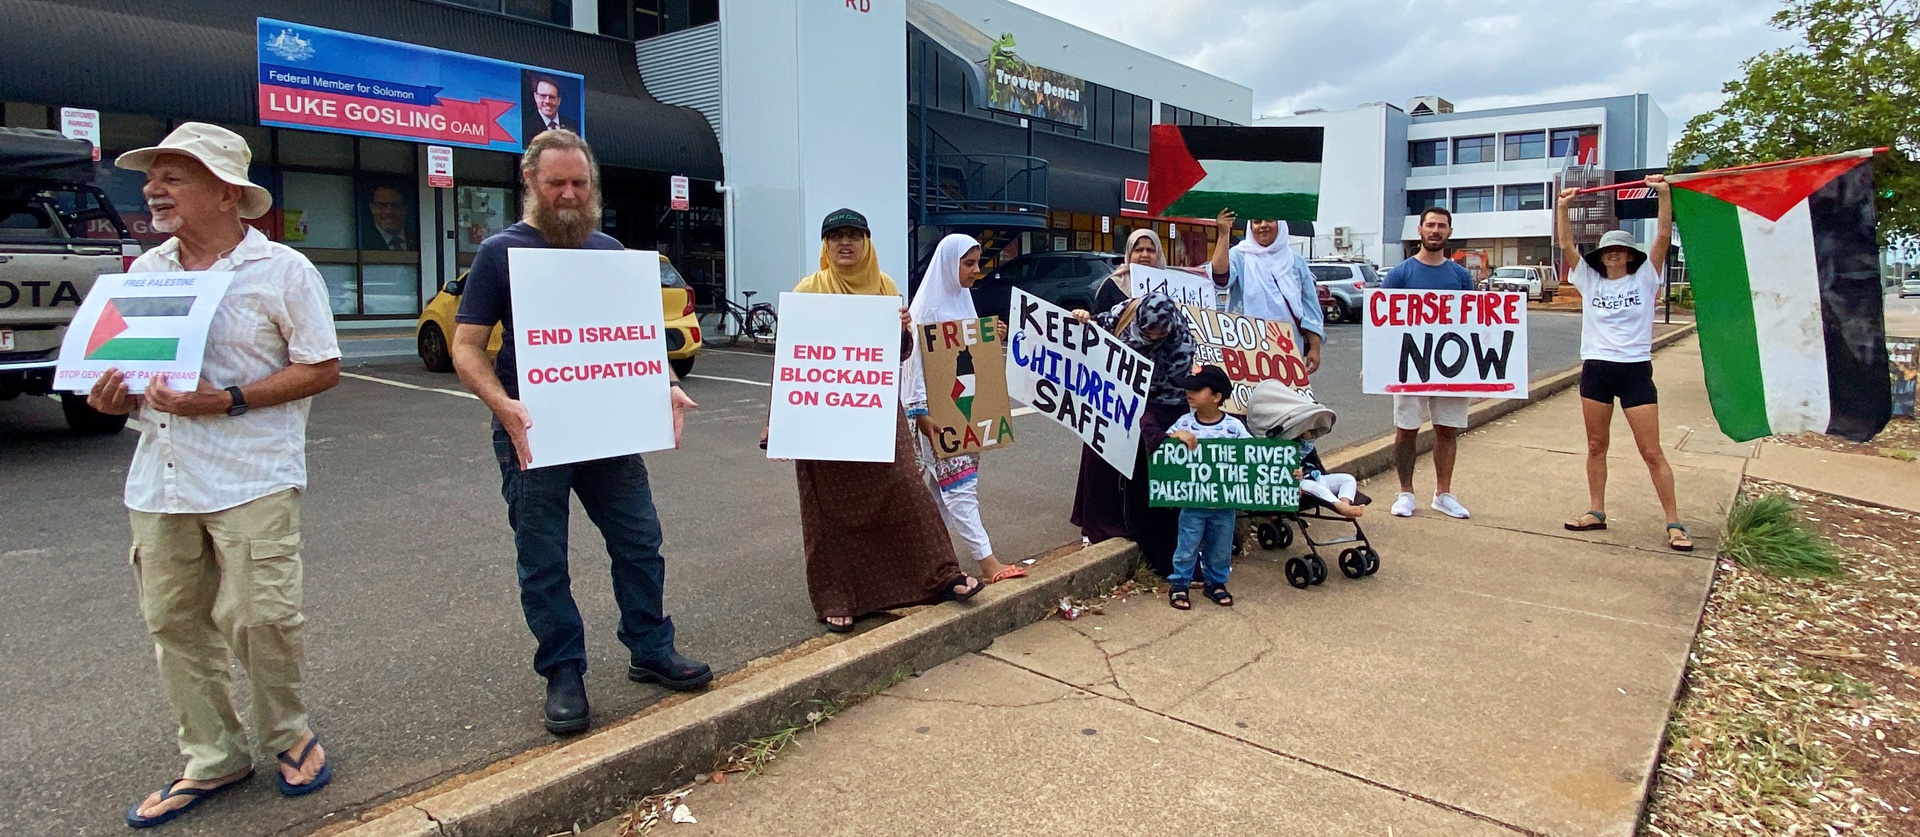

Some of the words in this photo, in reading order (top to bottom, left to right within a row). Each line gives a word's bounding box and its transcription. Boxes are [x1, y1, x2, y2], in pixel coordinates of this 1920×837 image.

[269, 70, 310, 85] Federal
[313, 76, 355, 92] Member
[357, 82, 370, 94] for
[372, 84, 414, 100] Solomon
[996, 69, 1040, 92] Trower
[1043, 81, 1080, 102] Dental
[64, 111, 96, 119] CUSTOMER
[68, 120, 93, 128] PARKING
[269, 92, 337, 118] LUKE
[345, 103, 446, 131] GOSLING
[450, 121, 485, 137] OAM
[73, 129, 88, 137] ONLY
[123, 278, 146, 287] FREE
[148, 277, 196, 287] PALESTINE
[1370, 290, 1455, 327] CEASE
[1460, 292, 1520, 327] FIRE
[1592, 296, 1641, 310] CEASEFIRE
[527, 328, 573, 346] END
[578, 325, 656, 343] ISRAELI
[923, 317, 995, 353] FREE
[1180, 304, 1270, 351] ALBO!
[793, 345, 836, 360] END
[842, 346, 884, 362] THE
[1020, 294, 1100, 356] KEEP
[1104, 337, 1151, 398] THE
[1194, 344, 1224, 363] HERE
[1398, 330, 1514, 383] NOW
[59, 370, 80, 379] STOP
[125, 371, 137, 379] OF
[527, 360, 662, 385] OCCUPATION
[780, 367, 894, 386] BLOCKADE
[1221, 348, 1310, 387] BLOOD
[1012, 330, 1139, 434] CHILDREN
[788, 390, 819, 406] ON
[825, 391, 883, 408] GAZA
[1032, 378, 1109, 455] SAFE
[939, 415, 1015, 453] GAZA
[1152, 442, 1203, 465] FROM
[1207, 444, 1237, 463] THE
[1245, 444, 1296, 465] RIVER
[1186, 463, 1212, 483] TO
[1216, 463, 1249, 483] THE
[1256, 464, 1294, 486] SEA
[1149, 479, 1219, 502] PALESTINE
[1222, 483, 1253, 505] WILL
[1254, 483, 1270, 505] BE
[1272, 485, 1299, 507] FREE
